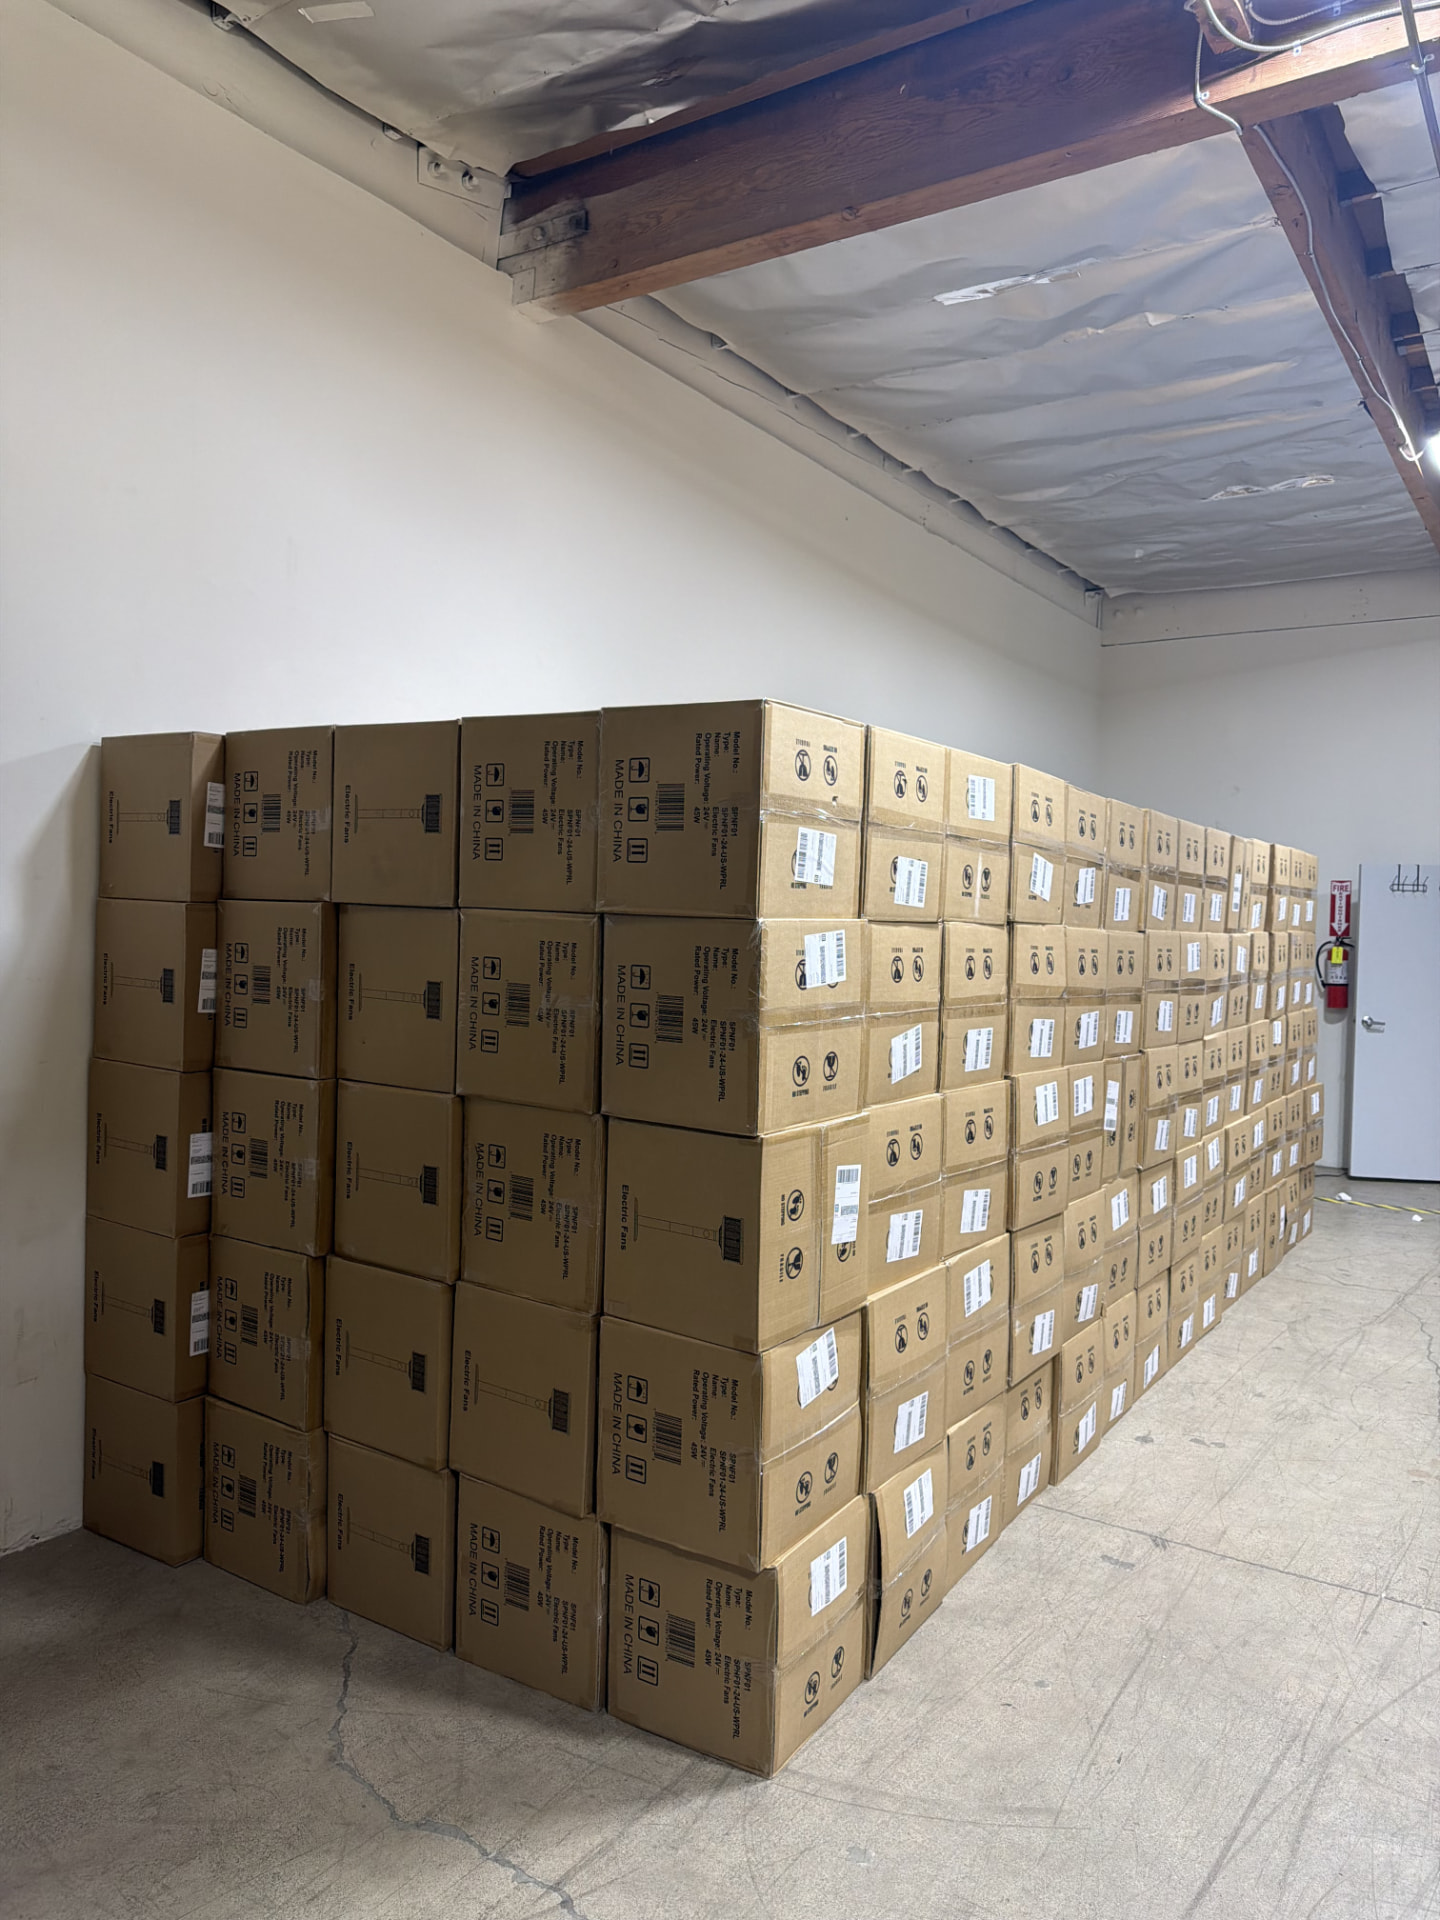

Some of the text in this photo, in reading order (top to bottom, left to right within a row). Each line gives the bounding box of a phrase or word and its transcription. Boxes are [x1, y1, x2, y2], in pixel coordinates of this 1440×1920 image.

[703, 733, 711, 771] Operating
[702, 774, 710, 804] Voltage:
[234, 809, 240, 819] IN
[472, 765, 482, 860] MADE IN CHINA
[613, 760, 624, 863] MADE IN CHINA
[702, 946, 710, 984] Operating
[721, 948, 729, 968] Type:
[226, 978, 231, 989] IN
[701, 986, 709, 1017] Voltage:
[469, 956, 479, 1051] MADE IN CHINA
[615, 965, 626, 1066] MADE IN CHINA
[223, 1147, 229, 1158] IN
[474, 1143, 484, 1238] MADE IN CHINA
[620, 1184, 629, 1252] Electric Fans
[462, 1350, 471, 1413] Electric Fans
[701, 1371, 709, 1411] Operating
[720, 1376, 728, 1398] Type:
[730, 1378, 738, 1403] Model
[612, 1372, 622, 1477] MADE IN CHINA
[700, 1412, 708, 1444] Voltage:
[468, 1523, 478, 1618] MADE IN CHINA
[714, 1580, 722, 1619] Operating
[734, 1587, 742, 1609] Type:
[744, 1590, 752, 1614] Model
[623, 1574, 634, 1677] MADE IN CHINA
[714, 1619, 722, 1652] Voltage:
[743, 1662, 751, 1694] SPNF01
